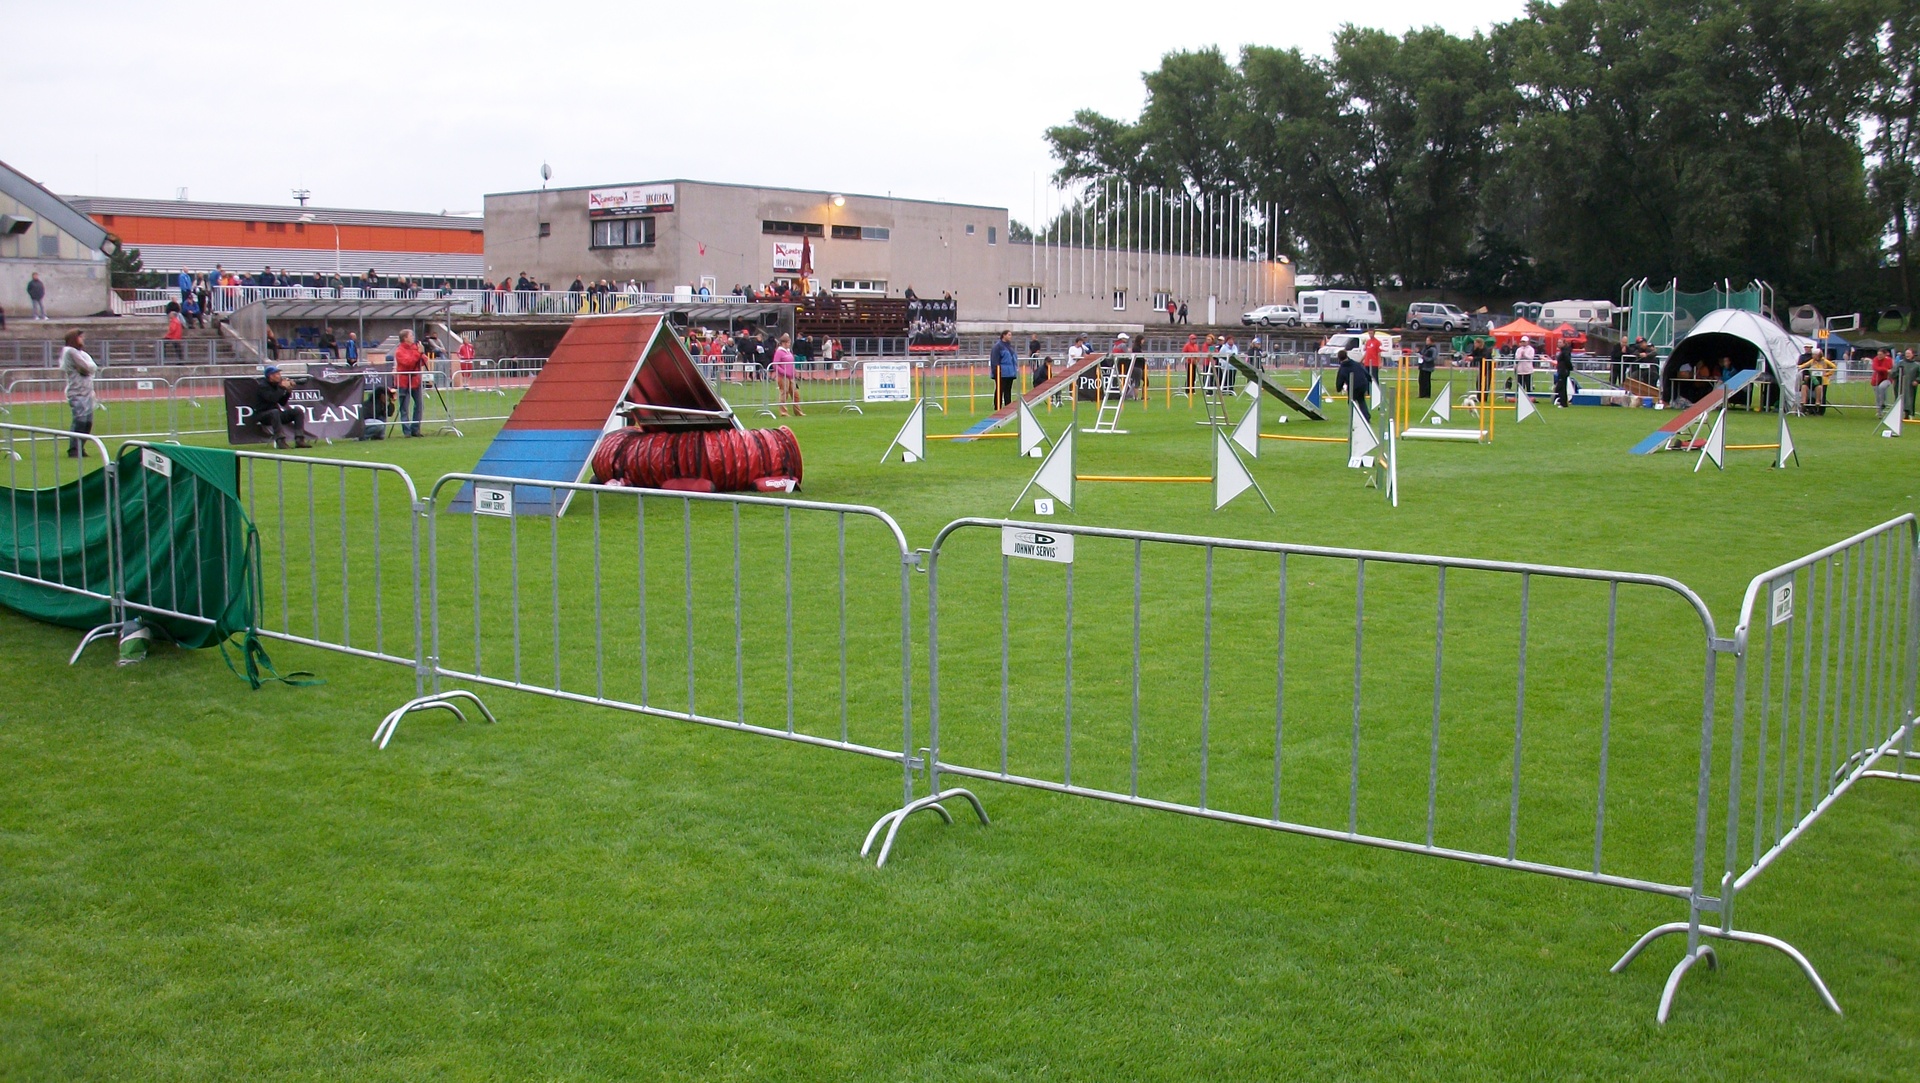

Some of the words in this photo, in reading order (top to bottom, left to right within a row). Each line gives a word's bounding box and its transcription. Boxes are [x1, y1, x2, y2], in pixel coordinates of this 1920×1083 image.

[289, 391, 318, 400] URINA
[1351, 459, 1360, 467] 17
[1040, 502, 1048, 513] 9
[1014, 543, 1036, 555] JOHNNY
[1035, 545, 1056, 558] SERVIS
